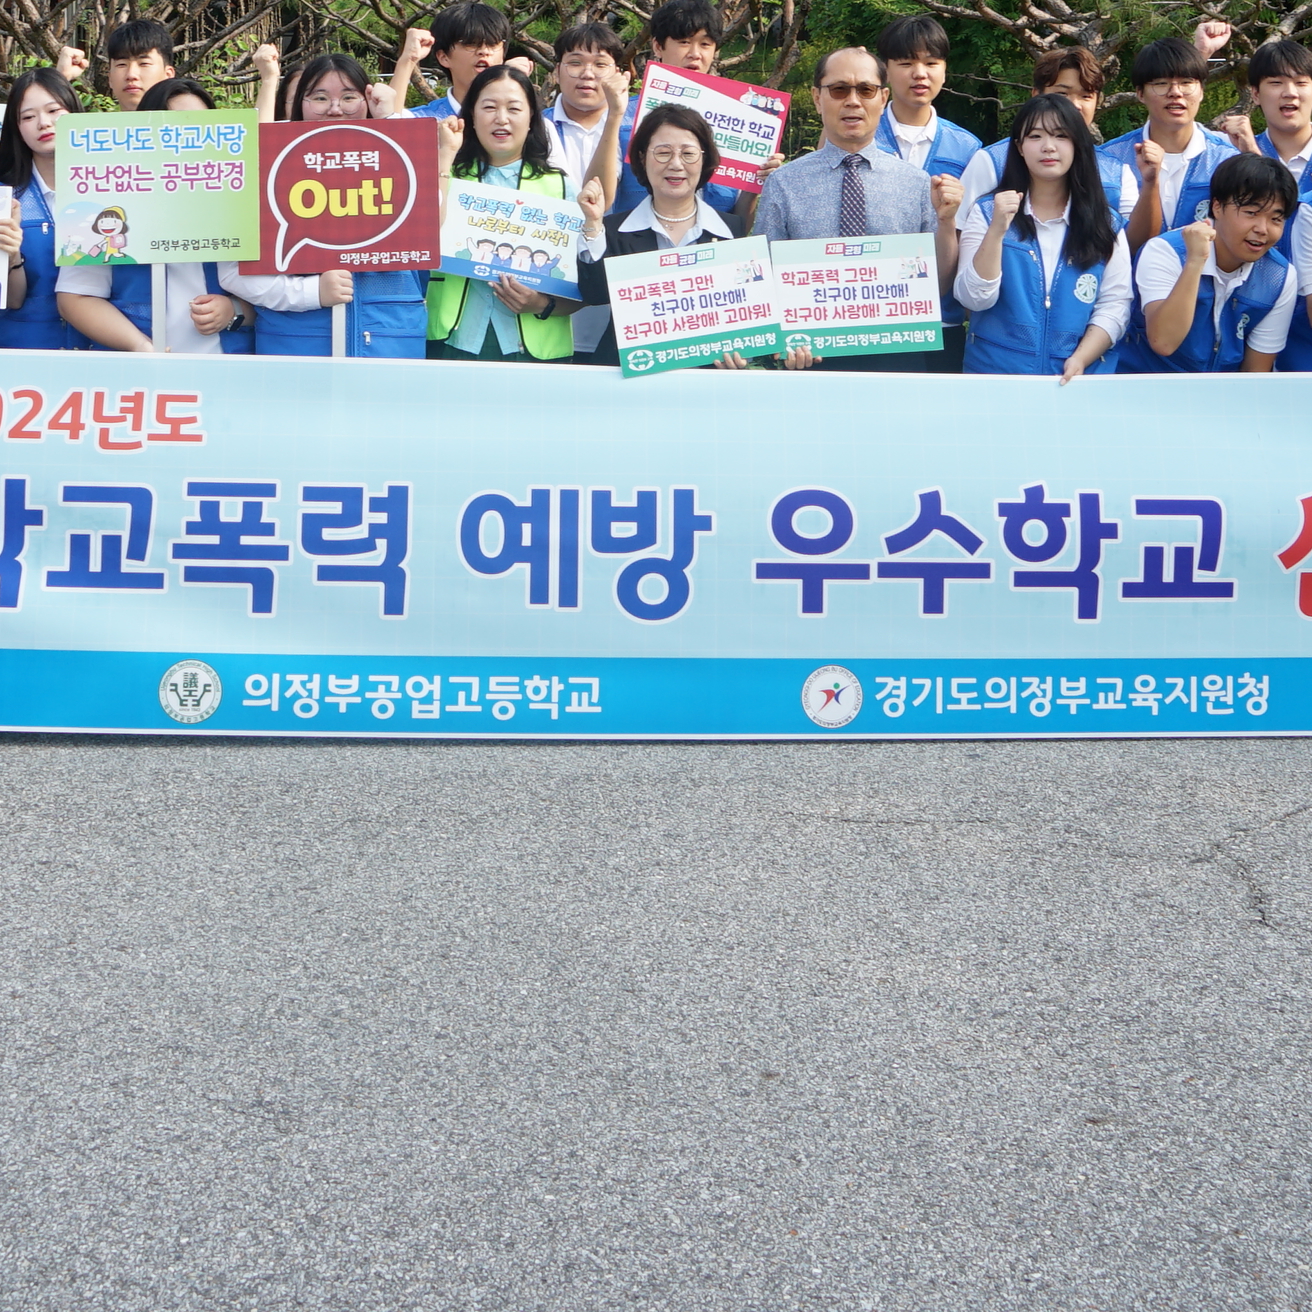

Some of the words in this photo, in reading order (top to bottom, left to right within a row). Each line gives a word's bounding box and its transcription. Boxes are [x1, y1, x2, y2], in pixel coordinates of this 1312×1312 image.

[70, 127, 154, 153] 너도나도
[158, 125, 245, 155] 학교사랑
[704, 109, 745, 134] 안전한
[748, 120, 776, 141] 학교
[303, 151, 380, 173] 학교폭력
[69, 164, 155, 195] 장난없는
[160, 161, 244, 193] 공부환경
[289, 177, 394, 219] Out!
[457, 192, 516, 219] 학교폭력
[519, 205, 548, 226] 없는
[150, 238, 241, 252] 의정부공업고등학교
[467, 216, 526, 237] 나로부터
[531, 229, 570, 248] 시작!
[339, 250, 431, 264] 의정부공업고등학교
[618, 280, 676, 302] 학교폭력
[680, 274, 714, 294] 그만!
[781, 268, 840, 286] 학교폭력
[844, 266, 878, 283] 그만!
[651, 296, 696, 317] 친구야
[699, 288, 747, 308] 미안해!
[813, 286, 857, 303] 친구야
[861, 283, 909, 300] 미안해!
[623, 320, 668, 341] 친구야
[672, 311, 720, 333] 사랑해!
[724, 303, 772, 325] 고마워!
[784, 306, 828, 323] 친구야
[832, 303, 880, 321] 사랑해!
[885, 300, 933, 317] 고마워!
[655, 333, 777, 364] 경기도의정부교육지원청
[814, 330, 936, 349] 경기도의정부교육지원청
[460, 488, 714, 621] 예방
[754, 484, 1236, 620] 우수학교
[242, 672, 602, 722] 의정부공업고등학교
[874, 672, 1270, 719] 경기도의정부교육지원청
